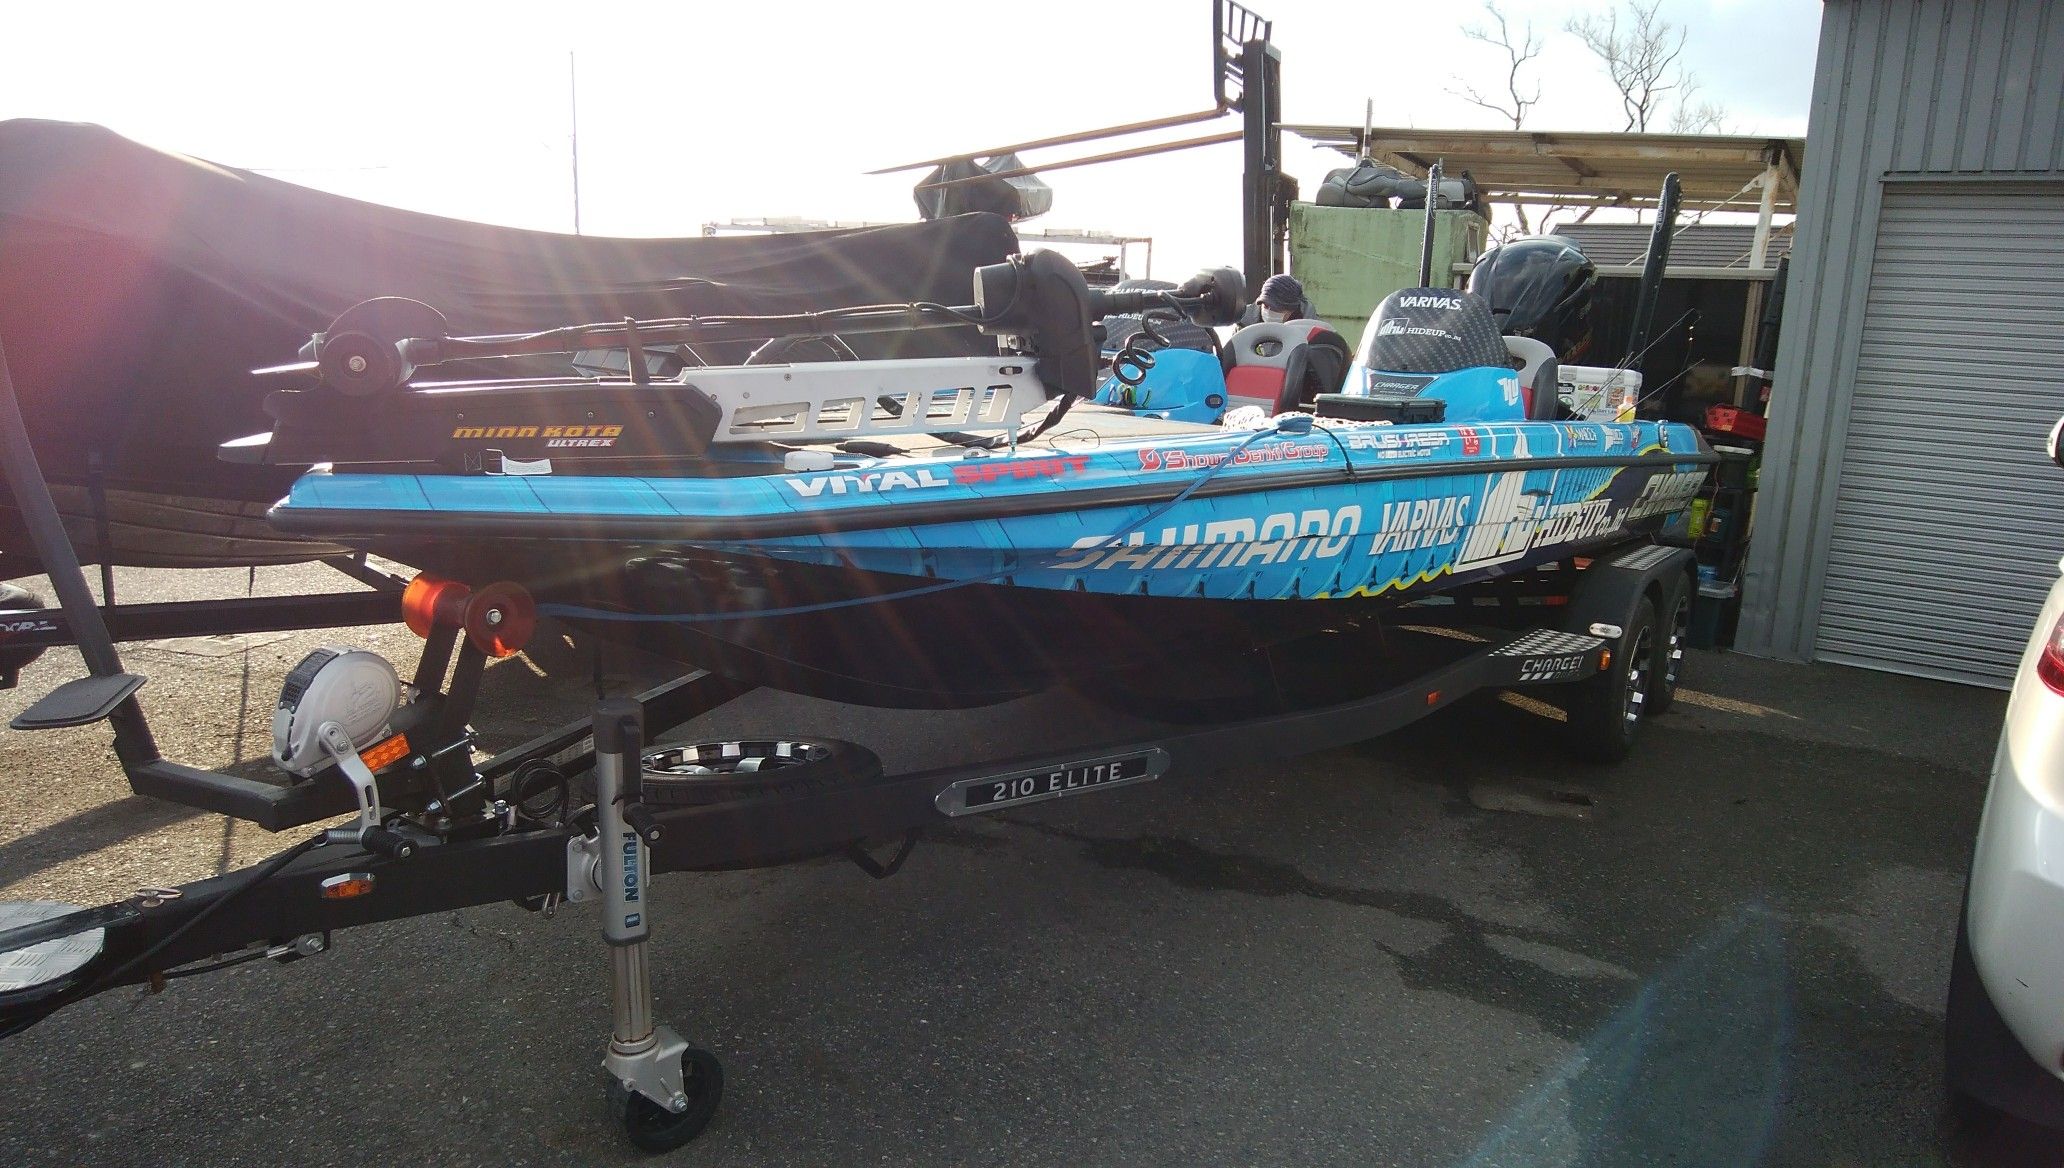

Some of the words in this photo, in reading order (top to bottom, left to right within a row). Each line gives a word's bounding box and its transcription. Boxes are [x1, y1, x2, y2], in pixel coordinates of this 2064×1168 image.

[1399, 296, 1462, 310] VARIVAS
[1406, 327, 1446, 337] HIDEUP
[541, 424, 624, 438] KOTA
[547, 438, 614, 448] ULTREX
[1230, 443, 1282, 464] Denki
[1281, 441, 1328, 463] Group
[785, 469, 950, 497] VITAL
[1047, 504, 1362, 570] SHIMANO
[1368, 495, 1472, 556] VARIVAS
[1532, 498, 1612, 549] HIDEUP
[992, 777, 1035, 802] 210
[1048, 761, 1122, 792] ELITE
[622, 832, 639, 902] FULTON
